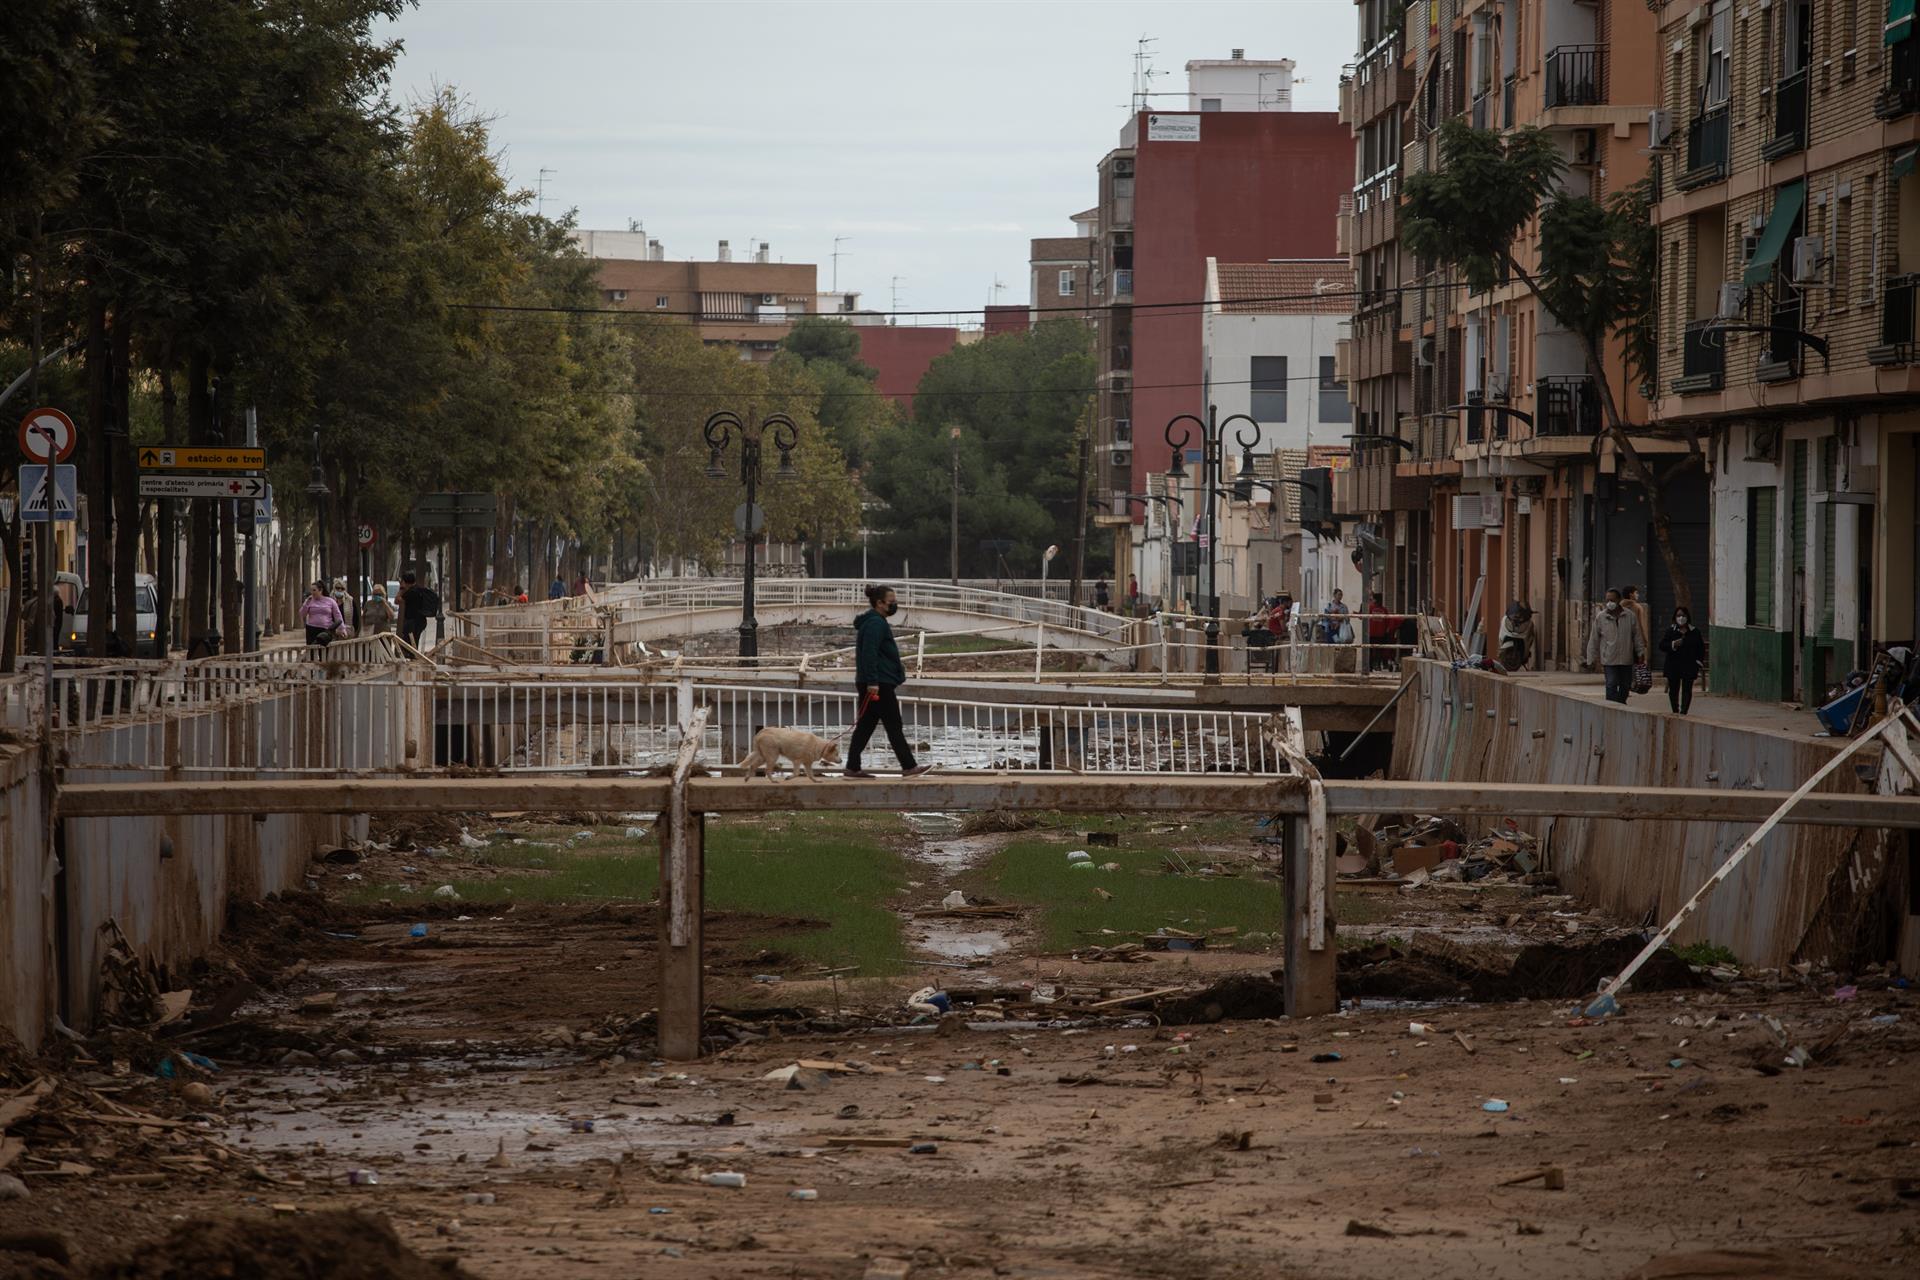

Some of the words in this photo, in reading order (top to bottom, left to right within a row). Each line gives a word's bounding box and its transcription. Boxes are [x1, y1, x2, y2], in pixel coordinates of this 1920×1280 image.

[226, 455, 238, 463] de
[243, 455, 262, 463] tren
[141, 479, 162, 487] centre
